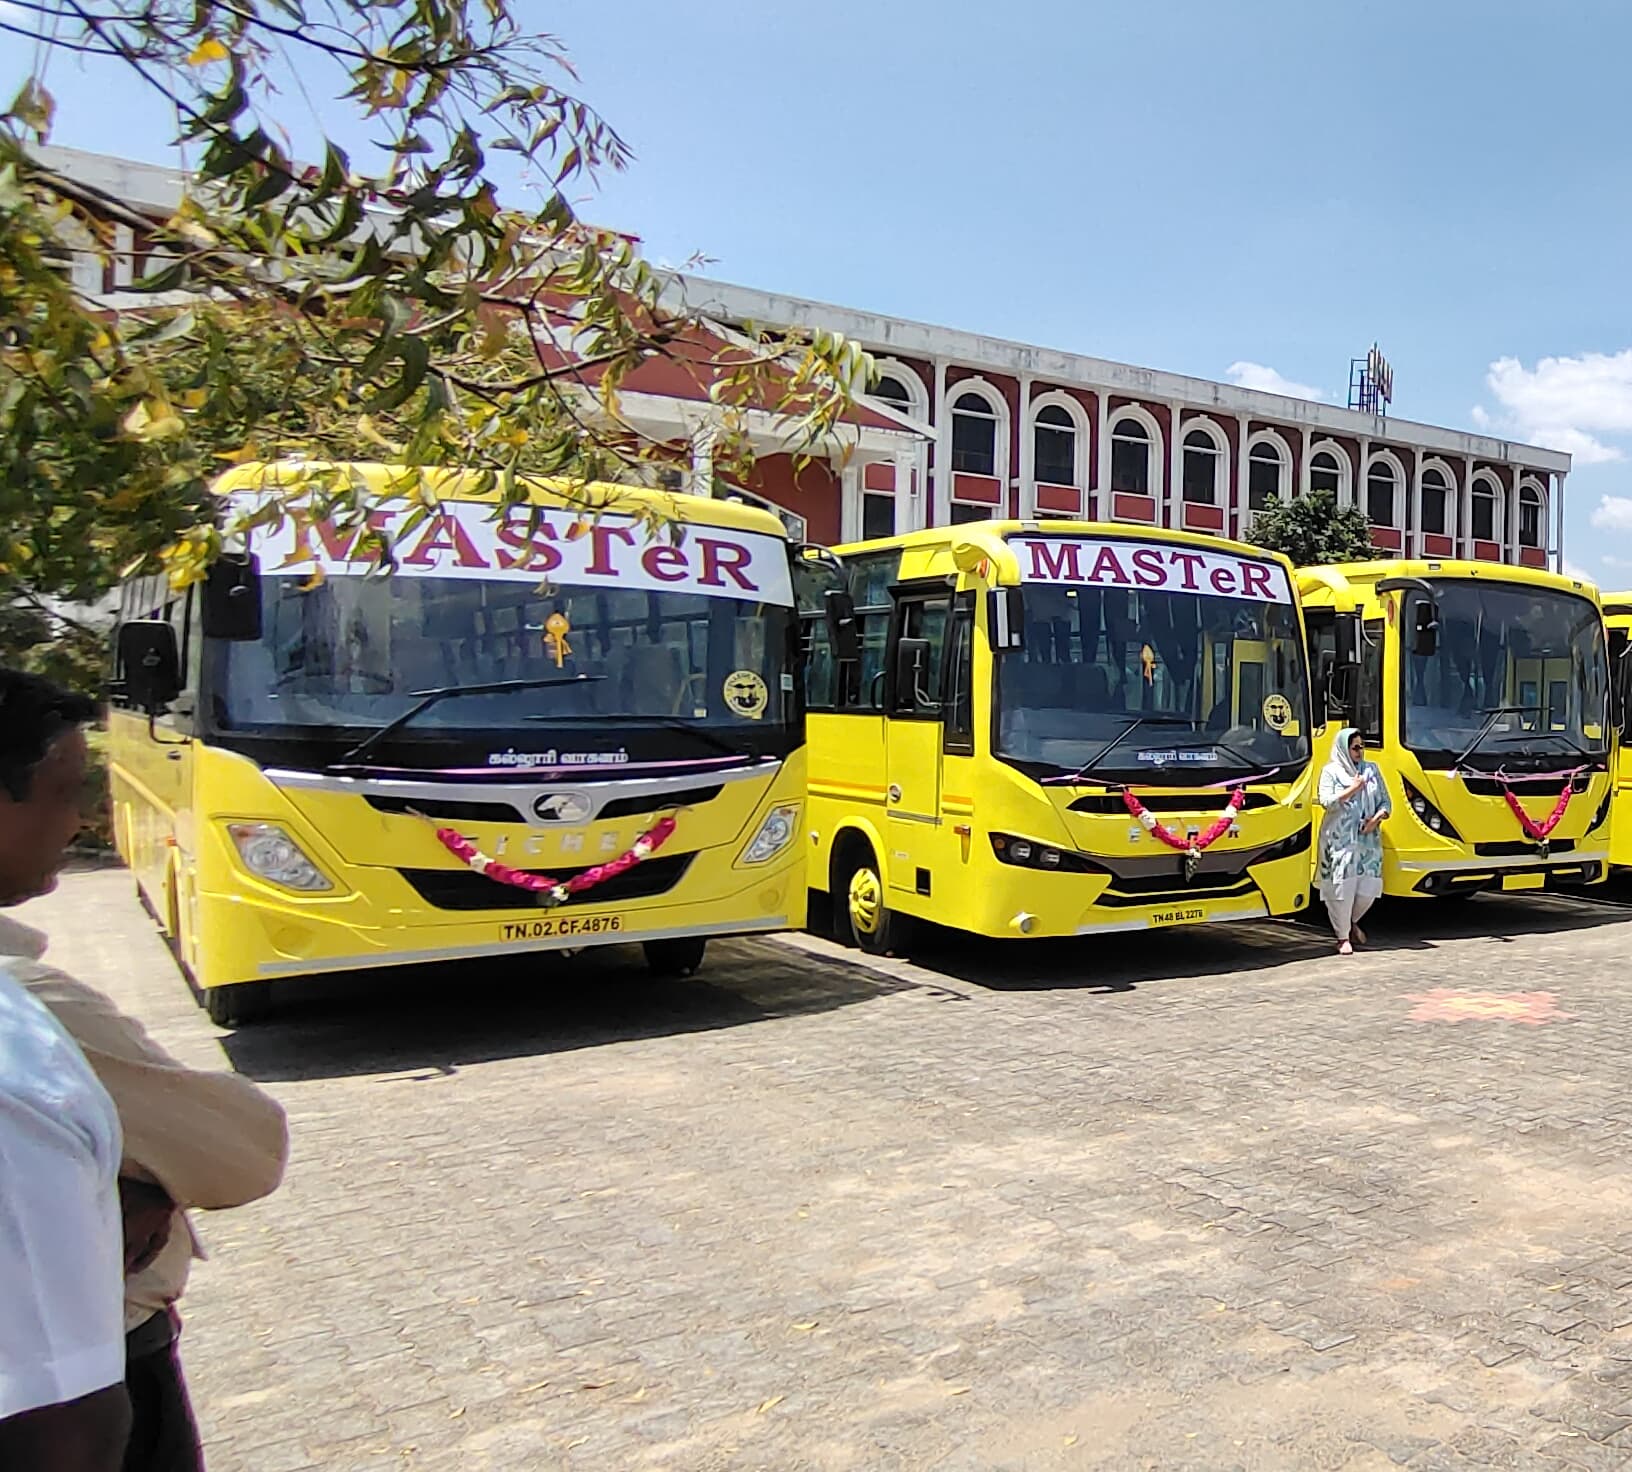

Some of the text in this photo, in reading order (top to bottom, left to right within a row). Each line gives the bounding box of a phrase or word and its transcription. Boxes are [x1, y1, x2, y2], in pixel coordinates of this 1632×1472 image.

[1025, 541, 1277, 599] MASTeR
[489, 748, 629, 769] கல்லூரி வாகனம்
[464, 831, 651, 856] ICHE
